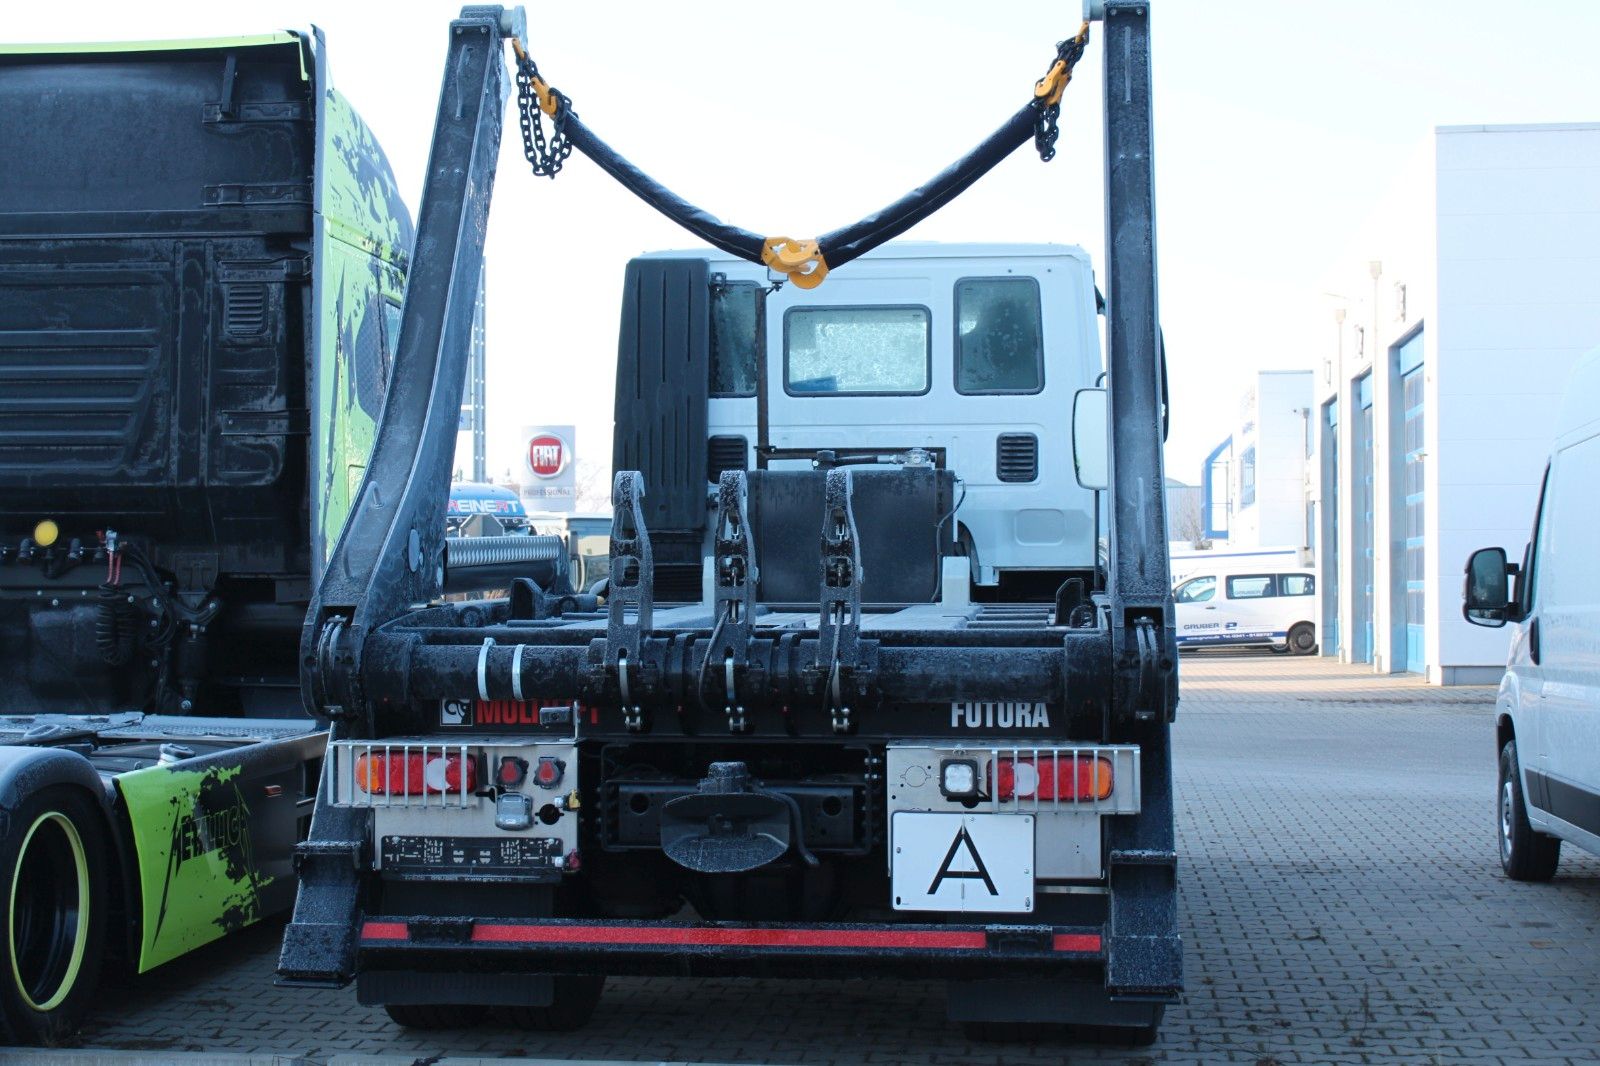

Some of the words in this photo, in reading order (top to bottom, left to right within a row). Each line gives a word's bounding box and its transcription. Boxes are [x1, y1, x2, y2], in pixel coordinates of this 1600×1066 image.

[533, 445, 560, 467] FIAT
[447, 500, 519, 513] REINERT
[1183, 622, 1220, 630] GRUBER
[951, 702, 1050, 728] FUTURA
[926, 824, 999, 896] A
